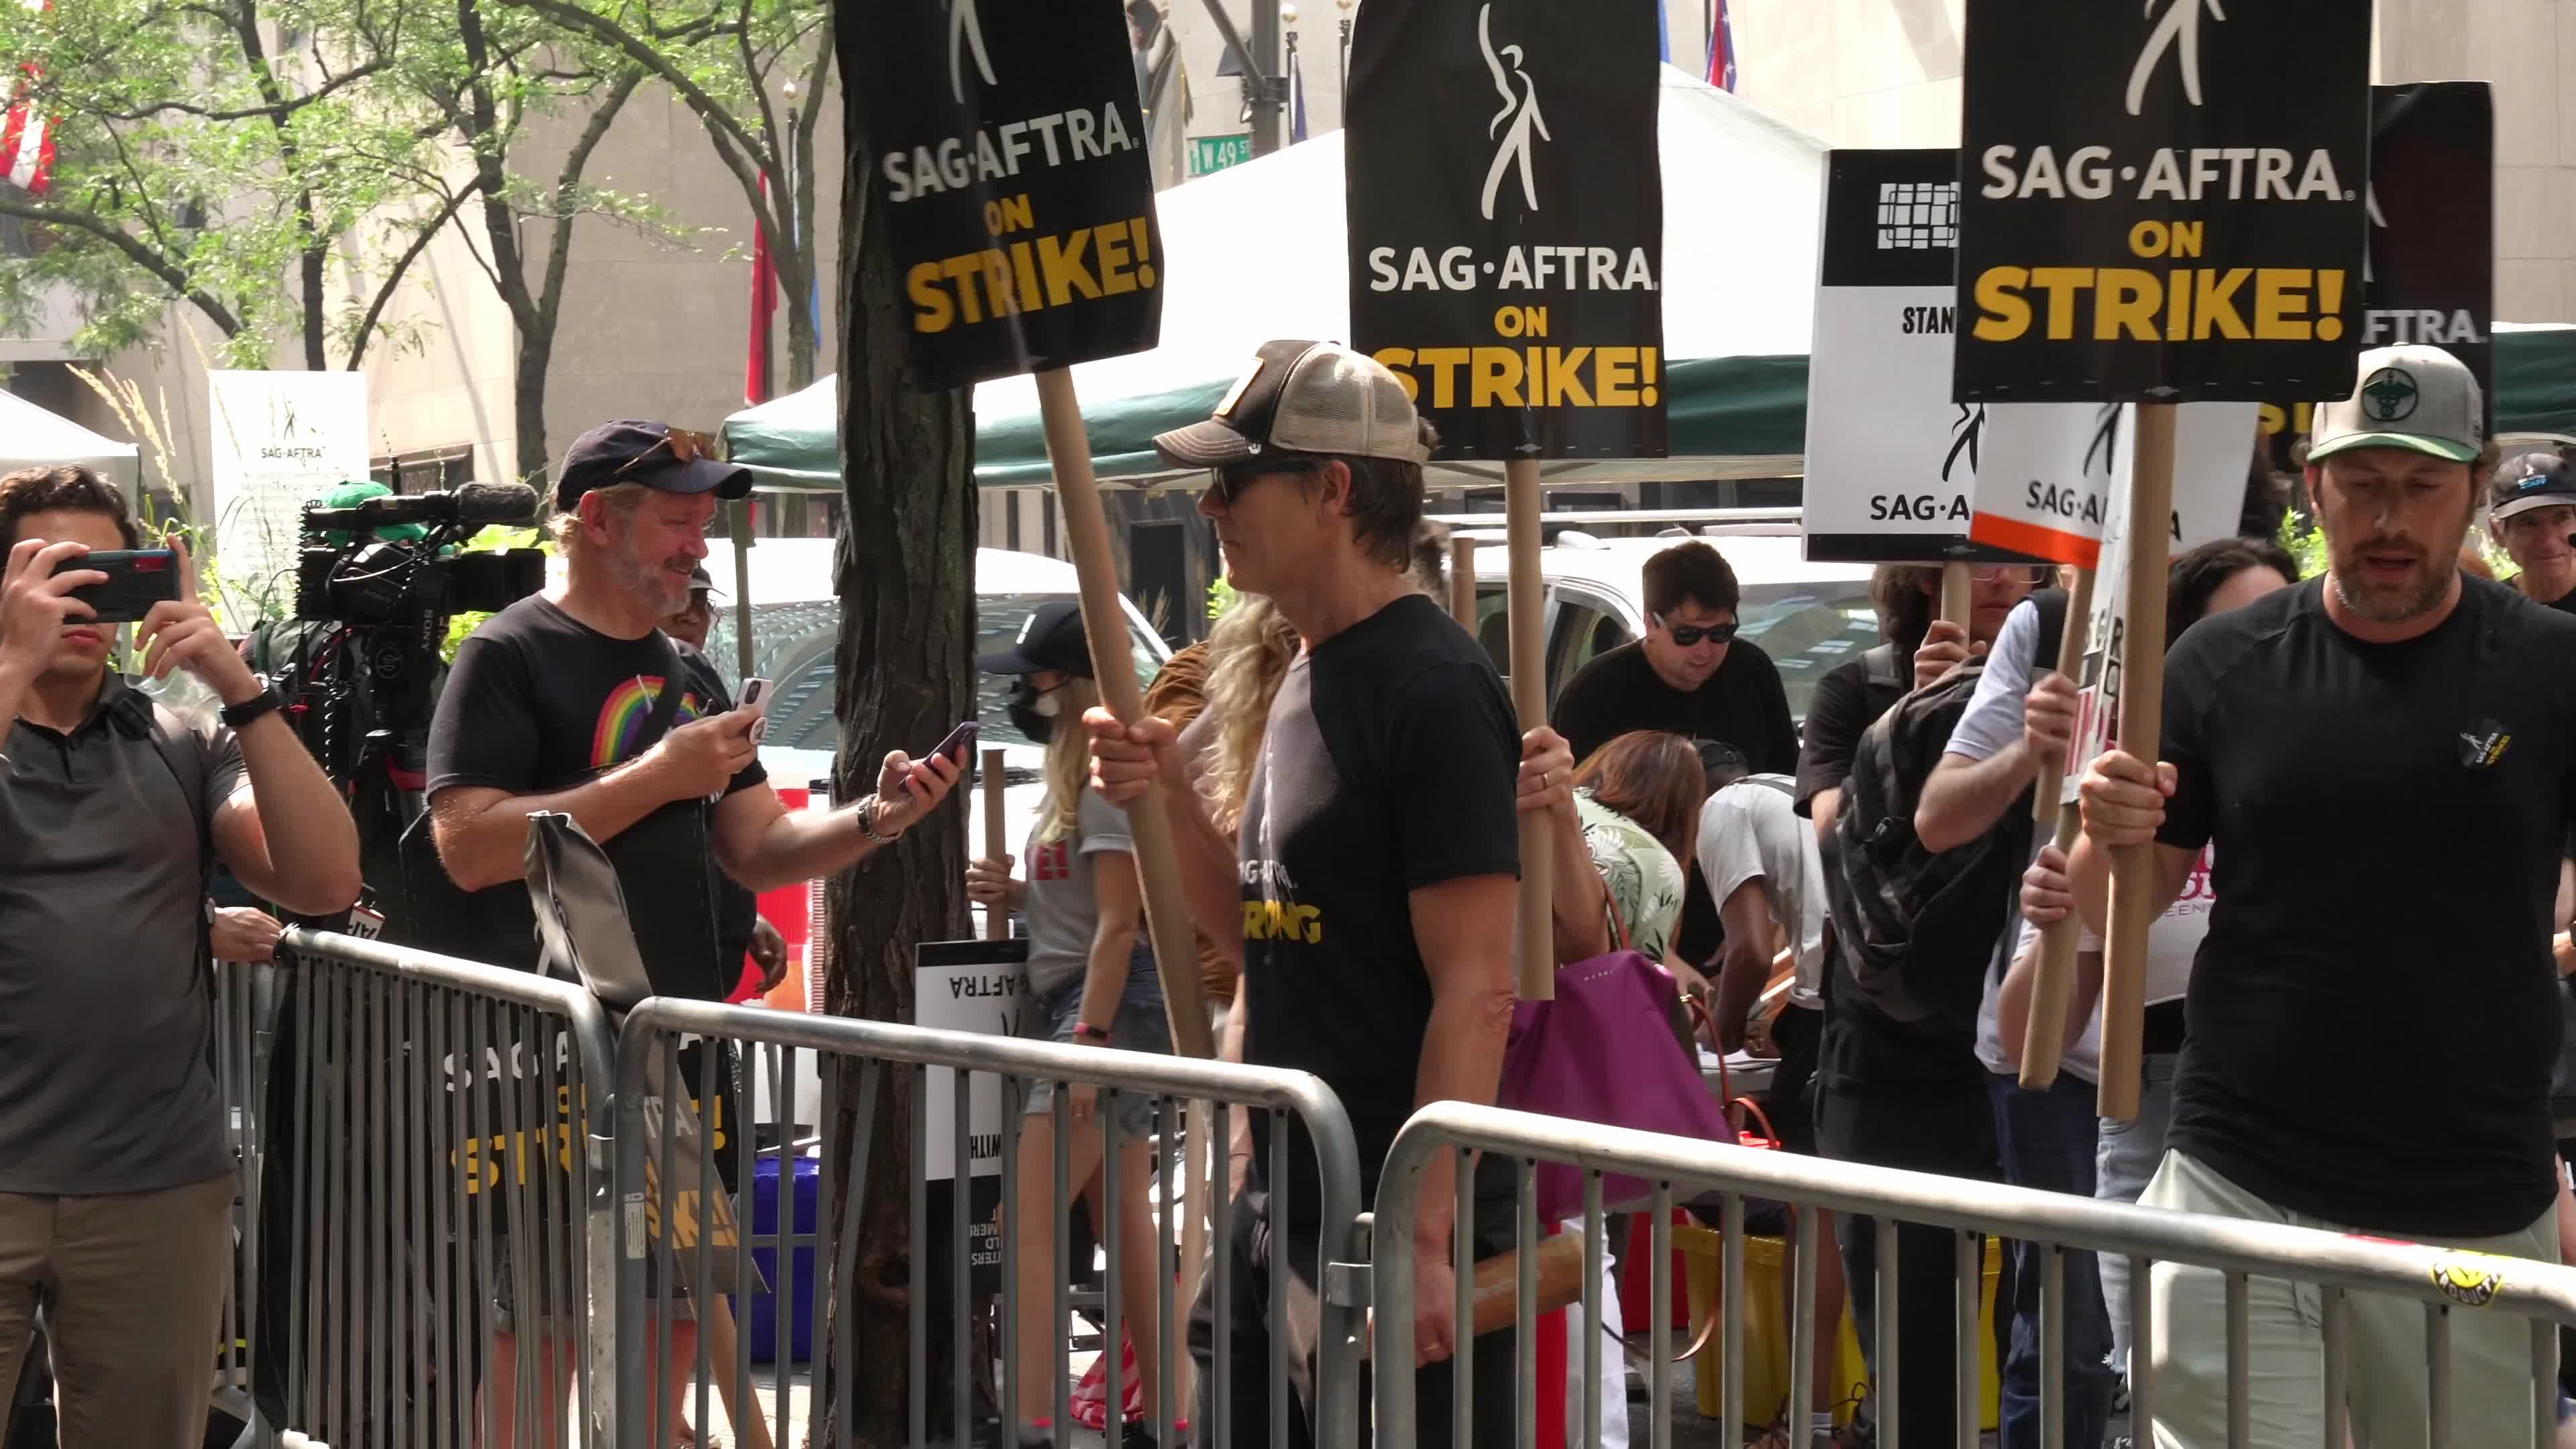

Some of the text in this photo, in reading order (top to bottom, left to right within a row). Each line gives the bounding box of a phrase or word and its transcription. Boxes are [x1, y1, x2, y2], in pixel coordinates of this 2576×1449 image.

[1201, 144, 1213, 170] W
[1218, 142, 1237, 168] 49
[983, 193, 1034, 237] ON
[2129, 220, 2204, 258] ON
[907, 216, 1155, 333] STRIKE!
[1494, 305, 1548, 337] ON
[1972, 265, 2345, 341] STRIKE!
[1371, 346, 1658, 409] STRIKE!
[421, 608, 433, 651] SONY
